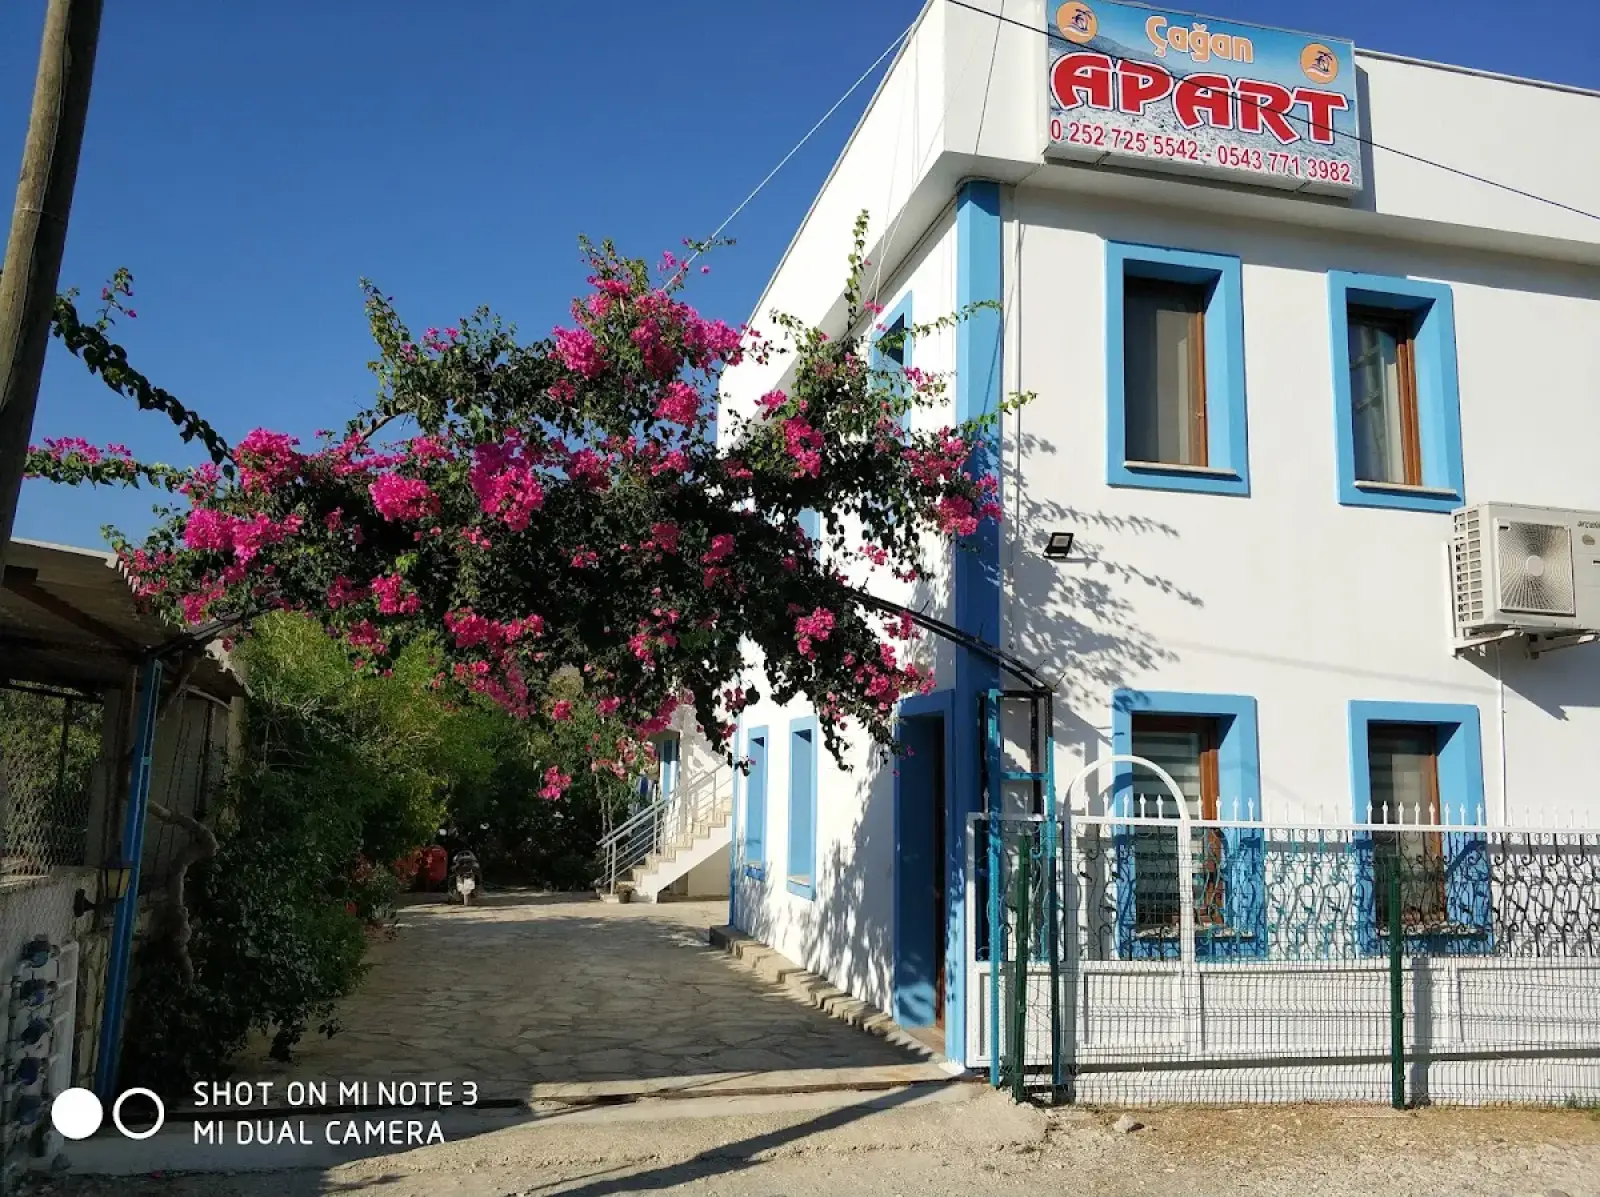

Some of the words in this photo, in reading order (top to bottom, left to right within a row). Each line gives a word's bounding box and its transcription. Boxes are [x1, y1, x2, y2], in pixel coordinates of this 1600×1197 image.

[1145, 16, 1254, 63] Çağan
[1051, 51, 1350, 145] APART
[1050, 119, 1061, 140] 0
[1068, 122, 1105, 146] 252
[1111, 128, 1147, 153] 725
[1153, 135, 1199, 160] 5542
[1217, 145, 1262, 170] 0543
[1268, 152, 1300, 176] 771
[1306, 158, 1351, 183] 3982
